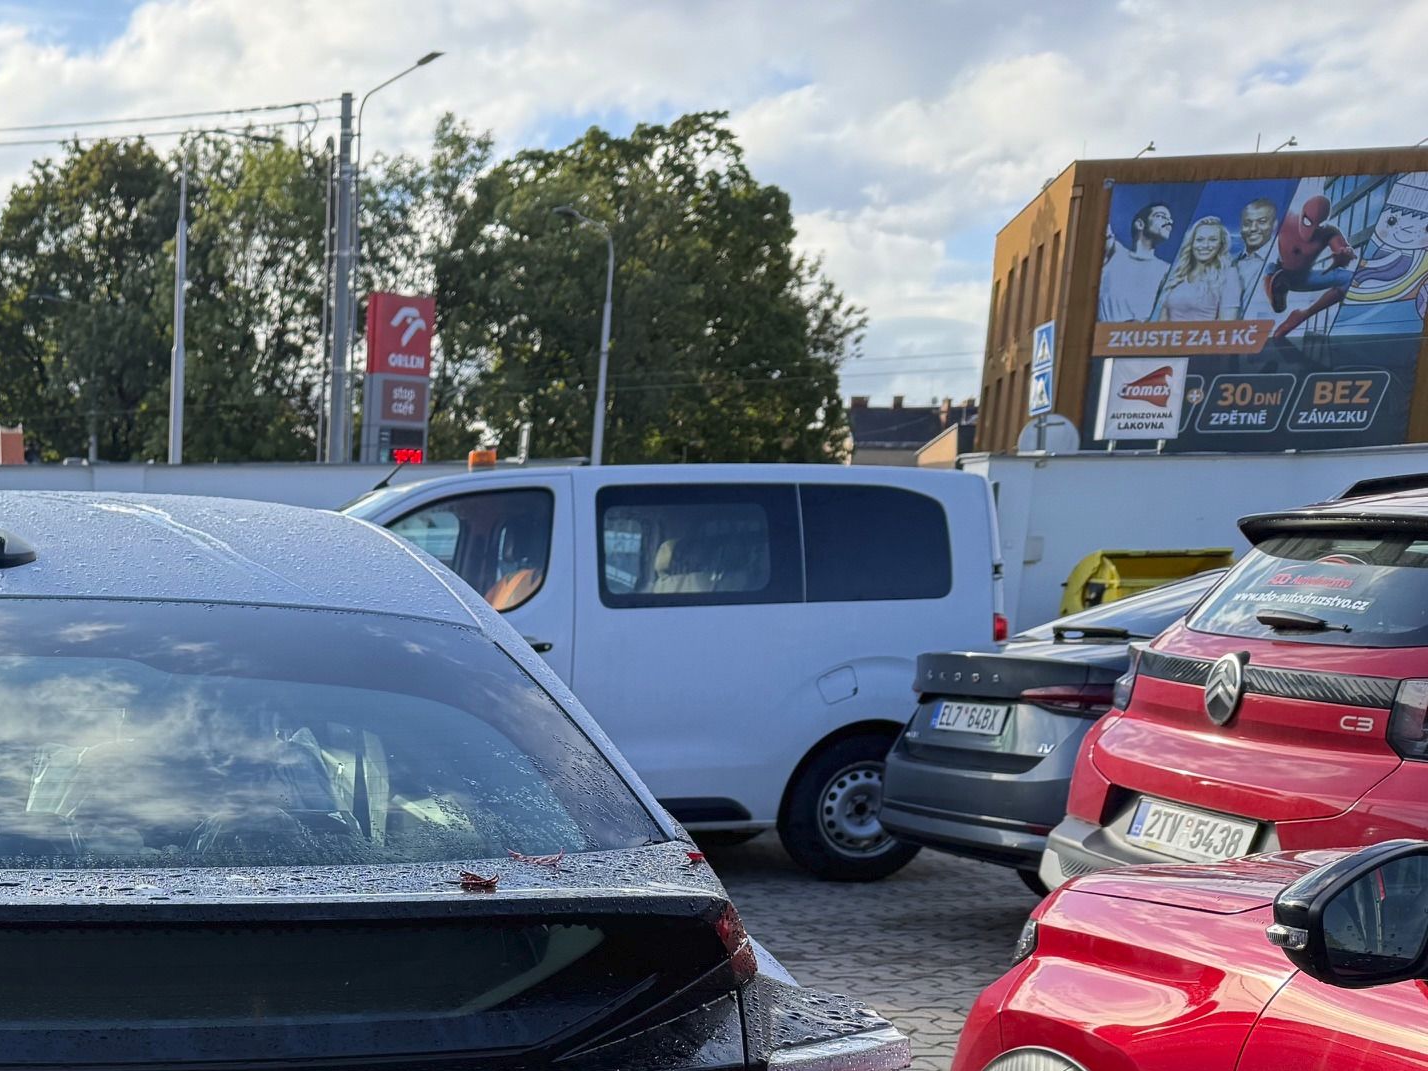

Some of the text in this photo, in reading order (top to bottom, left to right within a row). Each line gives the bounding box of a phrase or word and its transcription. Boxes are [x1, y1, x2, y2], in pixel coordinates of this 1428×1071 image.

[1108, 325, 1258, 348] ZKUSTE ZA 1 KČ
[388, 353, 425, 369] ORLEN
[1217, 382, 1284, 407] 30 DNÍ
[1313, 380, 1373, 405] BEZ
[1117, 422, 1164, 430] LAKOVNA
[1209, 410, 1267, 425] ZPĚTNĚ
[1297, 408, 1368, 424] ZÁVAZKU
[1233, 591, 1371, 611] www.ado-autodruzstvo.cz
[939, 704, 1000, 731] EL7 64BX
[1340, 715, 1374, 732] C3
[1144, 809, 1244, 858] 2TV 5438
